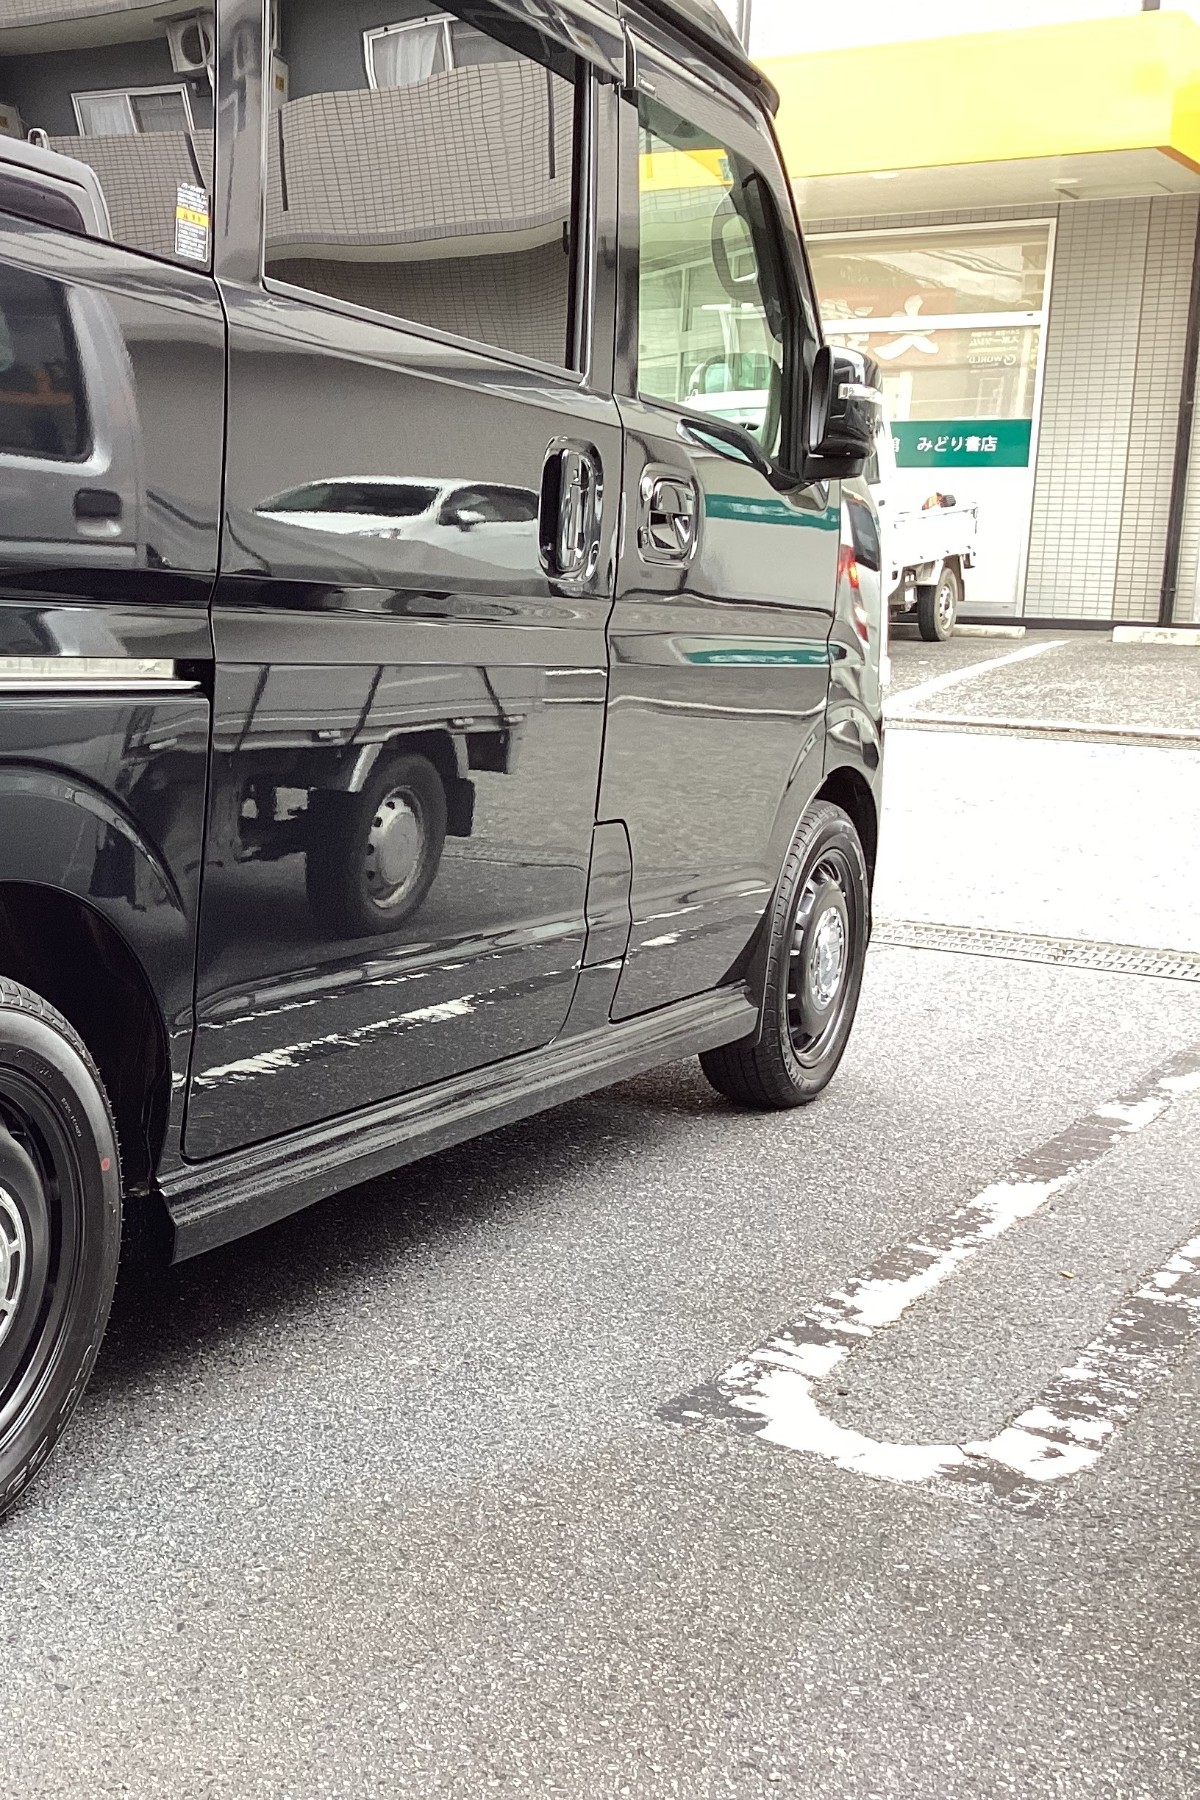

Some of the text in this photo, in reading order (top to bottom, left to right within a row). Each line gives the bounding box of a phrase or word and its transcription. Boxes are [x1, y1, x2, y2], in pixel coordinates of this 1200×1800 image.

[916, 435, 998, 452] みどり書店
